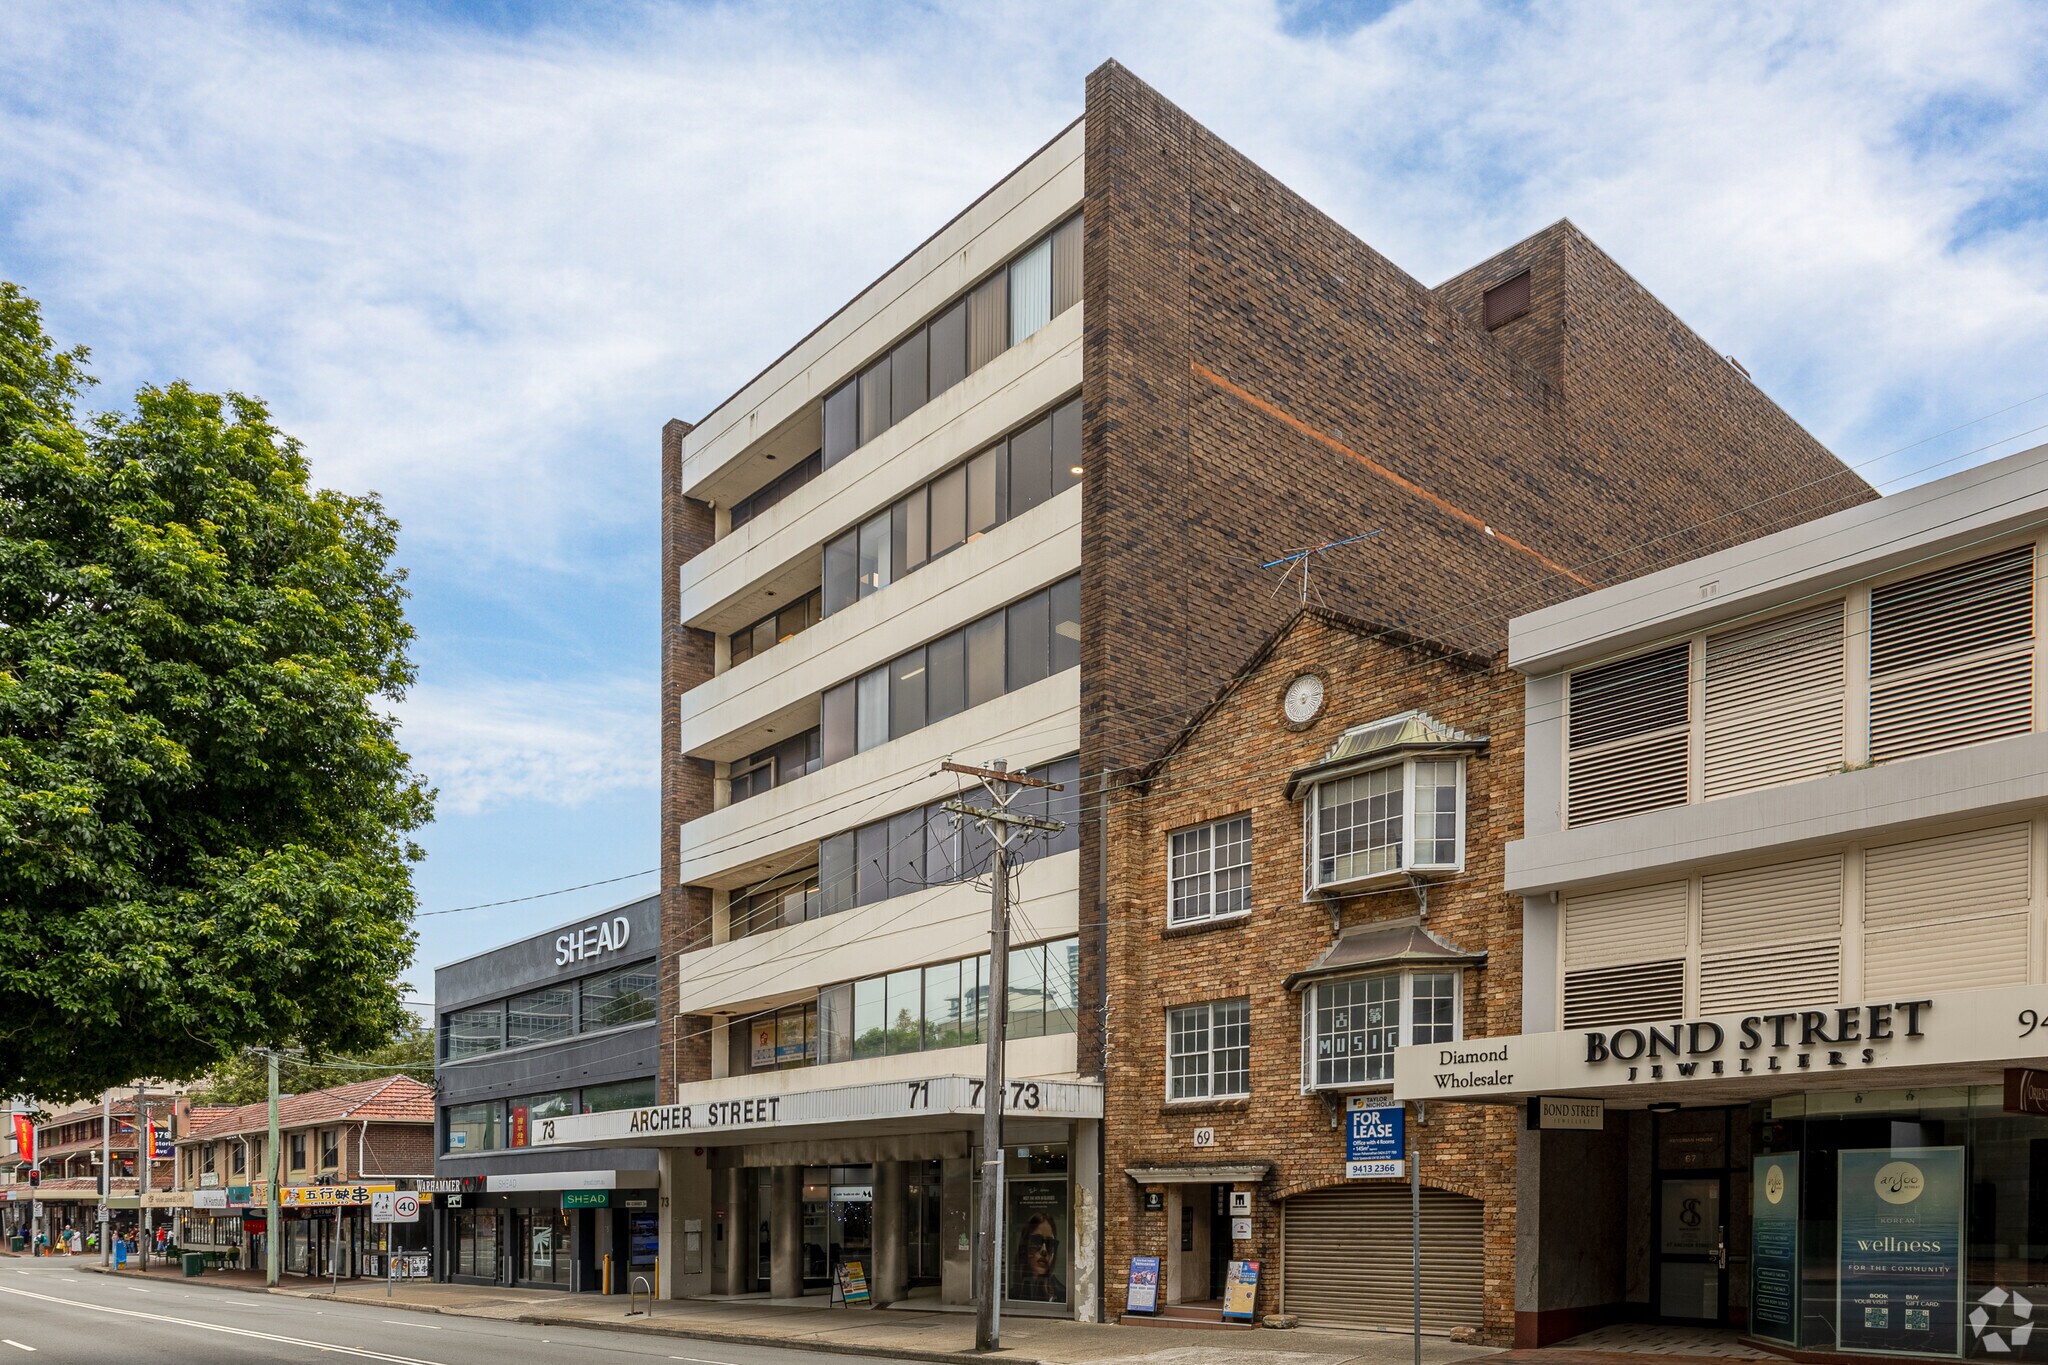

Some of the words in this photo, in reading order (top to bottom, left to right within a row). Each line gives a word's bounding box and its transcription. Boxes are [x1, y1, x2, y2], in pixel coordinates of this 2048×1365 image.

[555, 916, 630, 966] SHEAD
[1584, 1022, 1725, 1063] BOND
[1740, 999, 1933, 1050] STREET
[1320, 1031, 1397, 1055] MUSIC
[1439, 1045, 1509, 1066] Diamond
[1628, 1048, 1874, 1081] JEWELLERS
[1434, 1070, 1514, 1089] Wholesaler
[908, 1082, 928, 1109] 71
[1366, 1101, 1396, 1109] NICHOLAS
[1543, 1104, 1569, 1117] BOND
[1571, 1104, 1600, 1118] STREET
[630, 1107, 692, 1132] ARCHER
[708, 1097, 780, 1126] STREET
[1353, 1111, 1381, 1125] FOR
[543, 1120, 555, 1140] 73
[1197, 1130, 1211, 1145] 69
[1353, 1124, 1393, 1139] LEASE
[1685, 1155, 1697, 1163] 67
[1352, 1164, 1373, 1173] 9413
[1374, 1164, 1395, 1172] 2366
[416, 1179, 461, 1193] WARHAMMER
[498, 1178, 517, 1189] SHEAD
[567, 1194, 606, 1204] SHEAD
[660, 1197, 670, 1208] 73
[399, 1202, 415, 1212] 40
[1857, 1236, 1941, 1252] wellness
